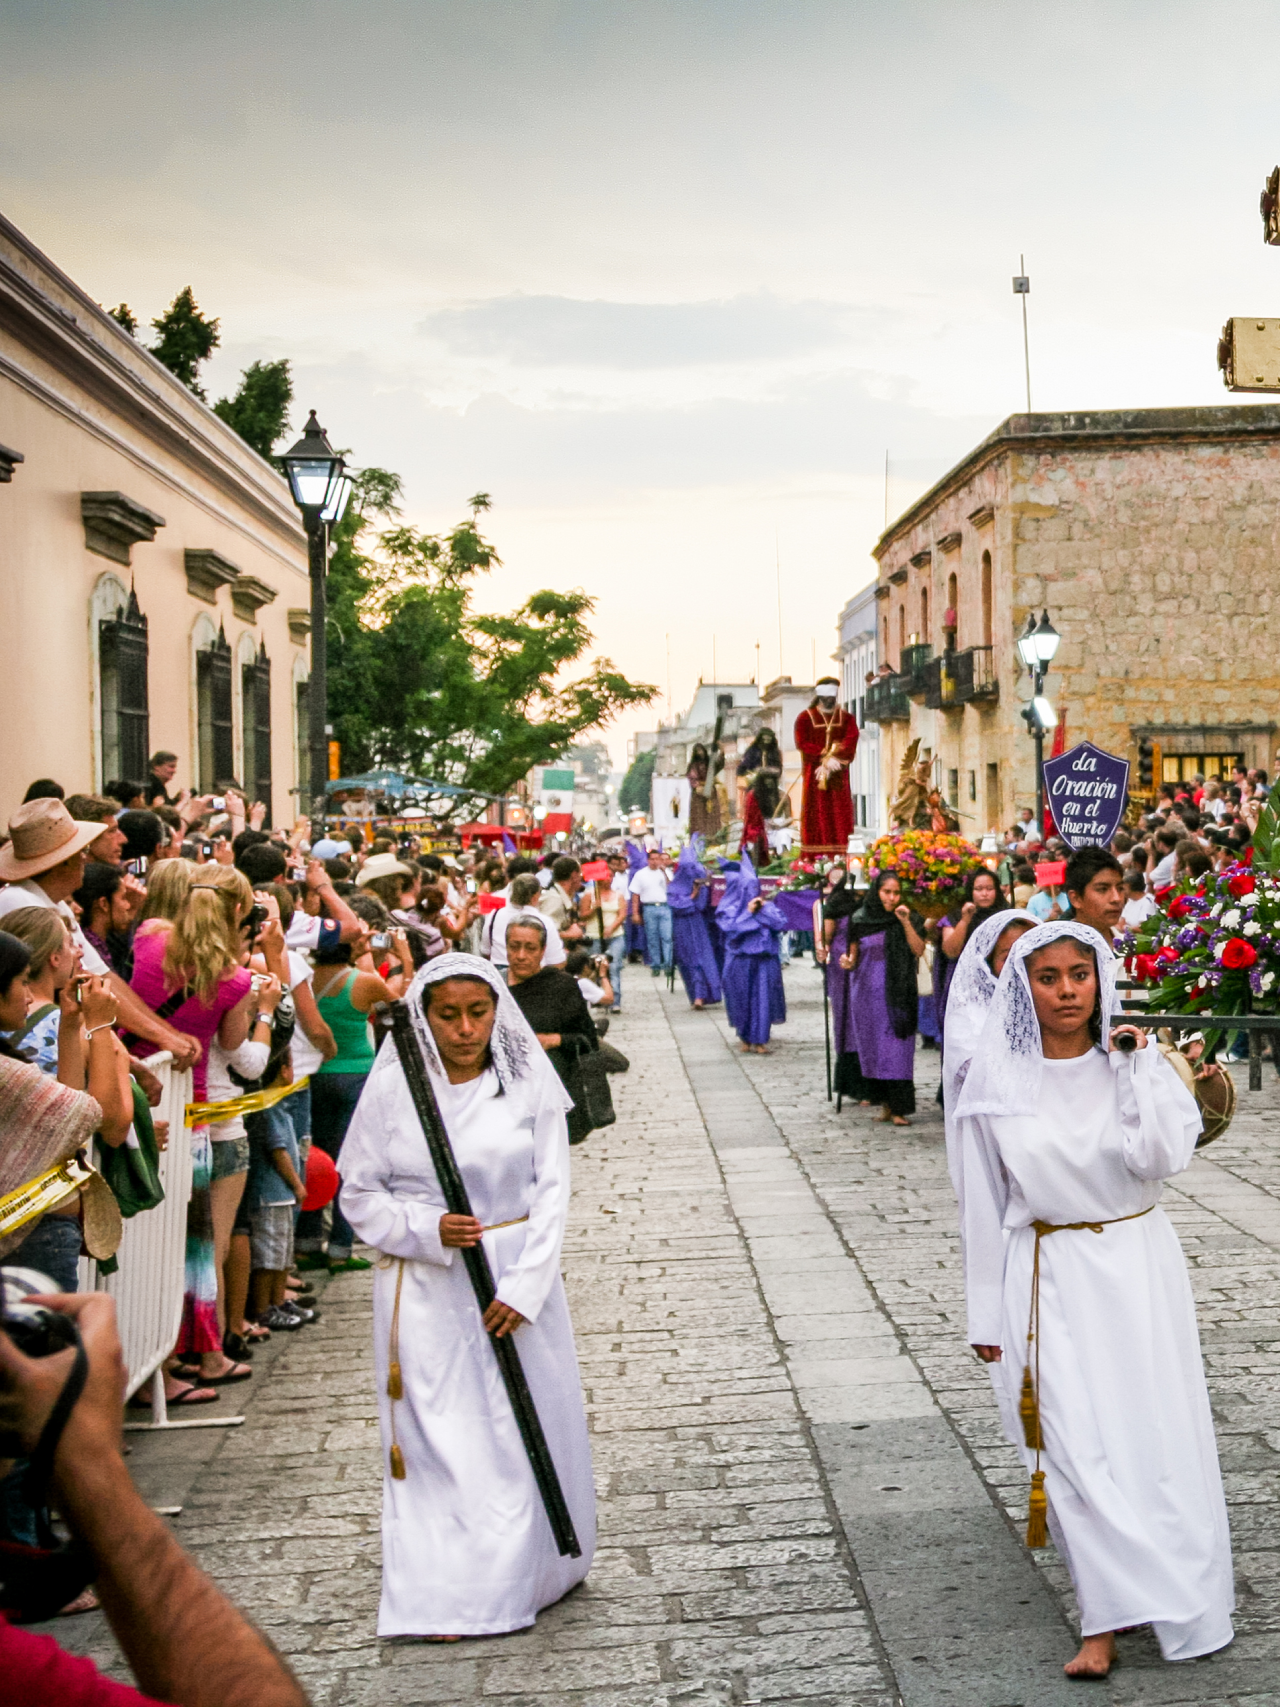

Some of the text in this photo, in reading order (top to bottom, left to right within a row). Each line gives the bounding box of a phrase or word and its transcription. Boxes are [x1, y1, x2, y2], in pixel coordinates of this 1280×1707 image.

[1052, 775, 1117, 799] Oración
[1062, 799, 1101, 817] en el
[1061, 817, 1108, 835] Huerto
